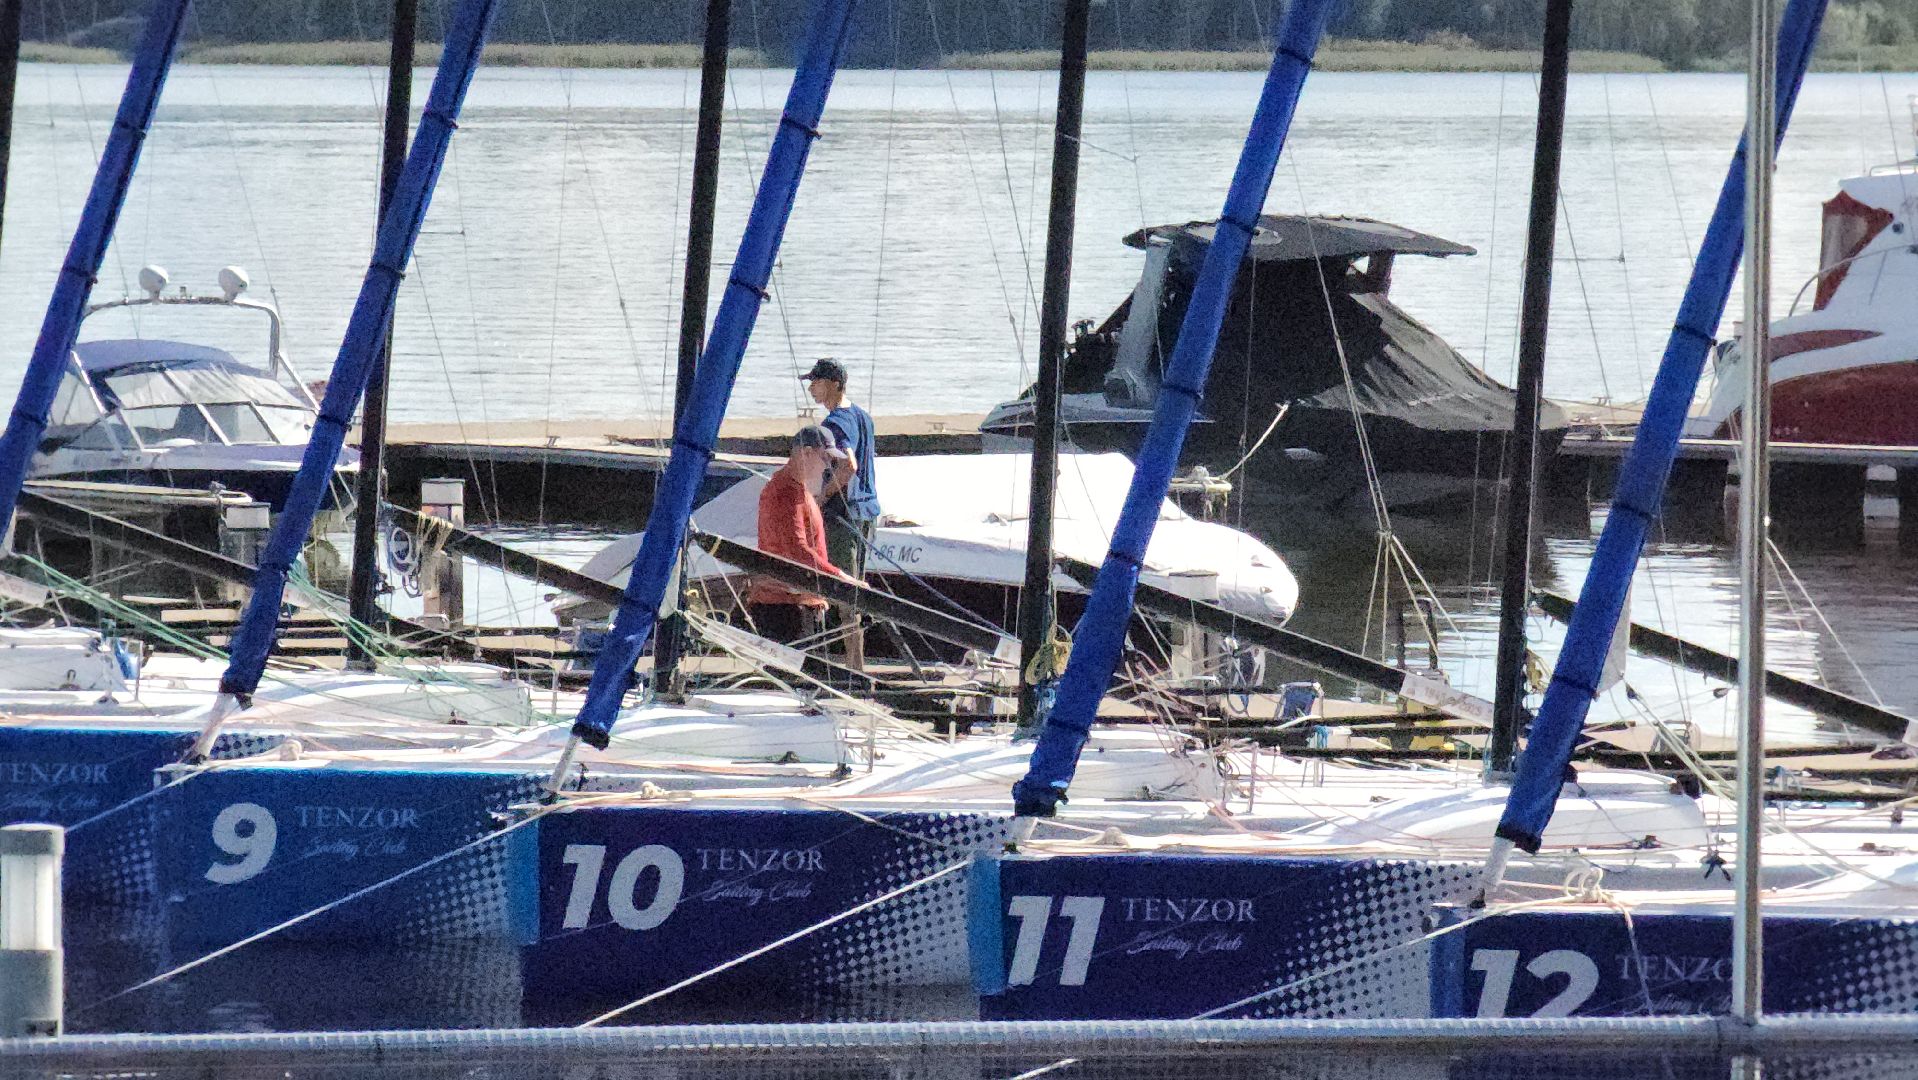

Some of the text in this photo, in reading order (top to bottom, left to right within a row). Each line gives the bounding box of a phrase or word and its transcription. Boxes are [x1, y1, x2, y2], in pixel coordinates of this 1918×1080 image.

[294, 805, 420, 828] TENZOR
[204, 803, 278, 885] 9
[696, 848, 826, 872] TENZOR
[562, 844, 685, 930] 10
[769, 881, 812, 901] Club
[1121, 898, 1255, 922] TENZOR
[1008, 896, 1106, 986] 11
[1198, 931, 1243, 954] Club
[1615, 954, 1734, 982] TENZO
[1470, 949, 1600, 1018] 12
